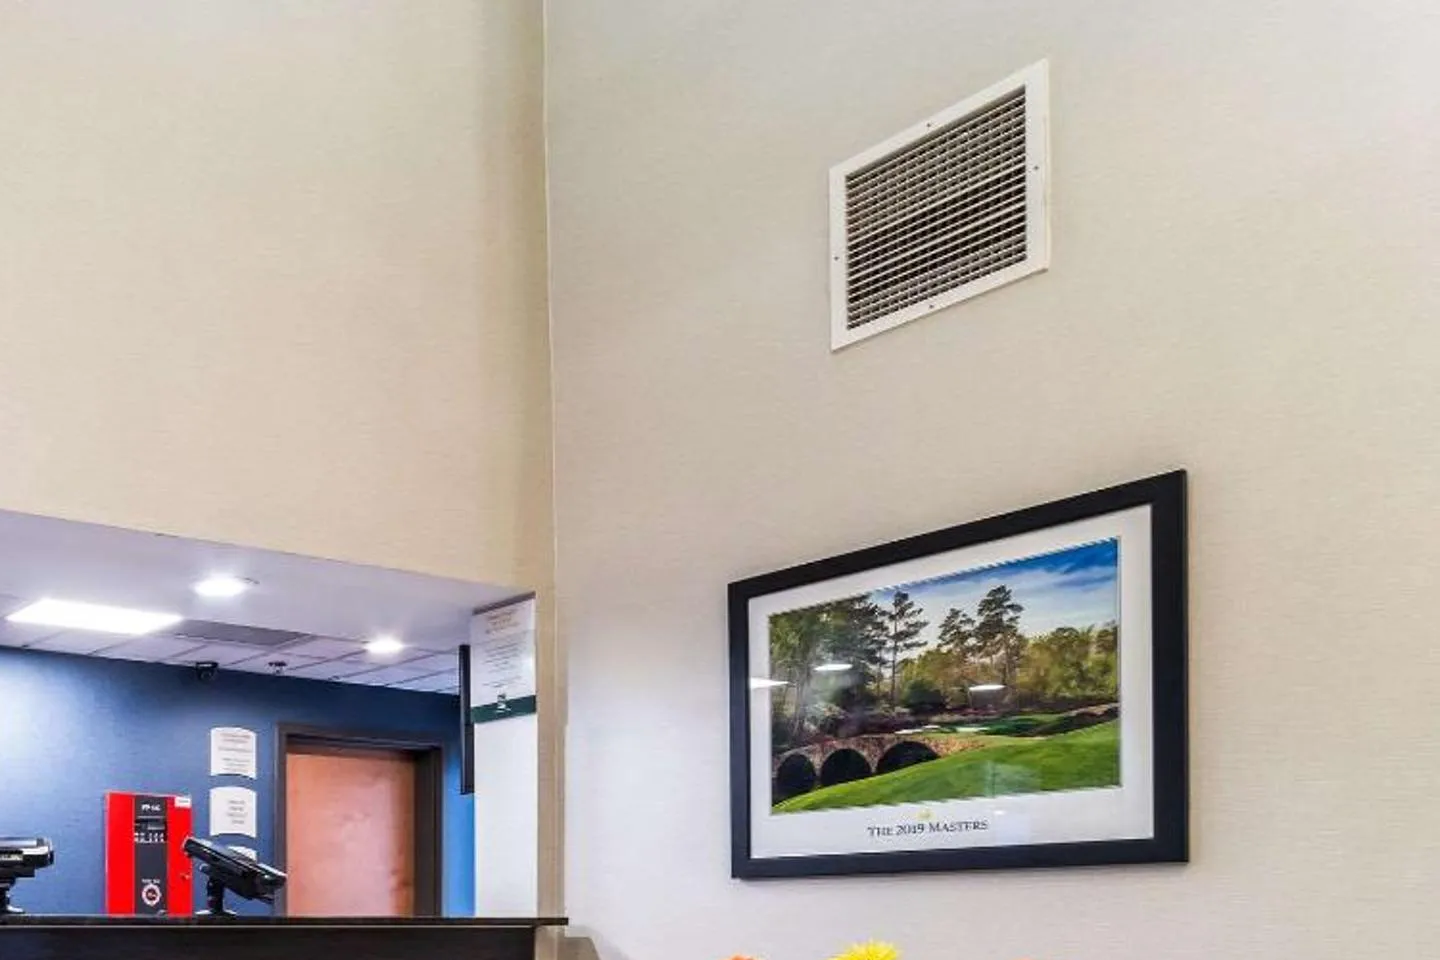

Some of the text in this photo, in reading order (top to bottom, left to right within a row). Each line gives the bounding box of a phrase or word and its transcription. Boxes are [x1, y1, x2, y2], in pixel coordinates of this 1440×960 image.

[867, 819, 989, 838] THE 2019 MASTERS
